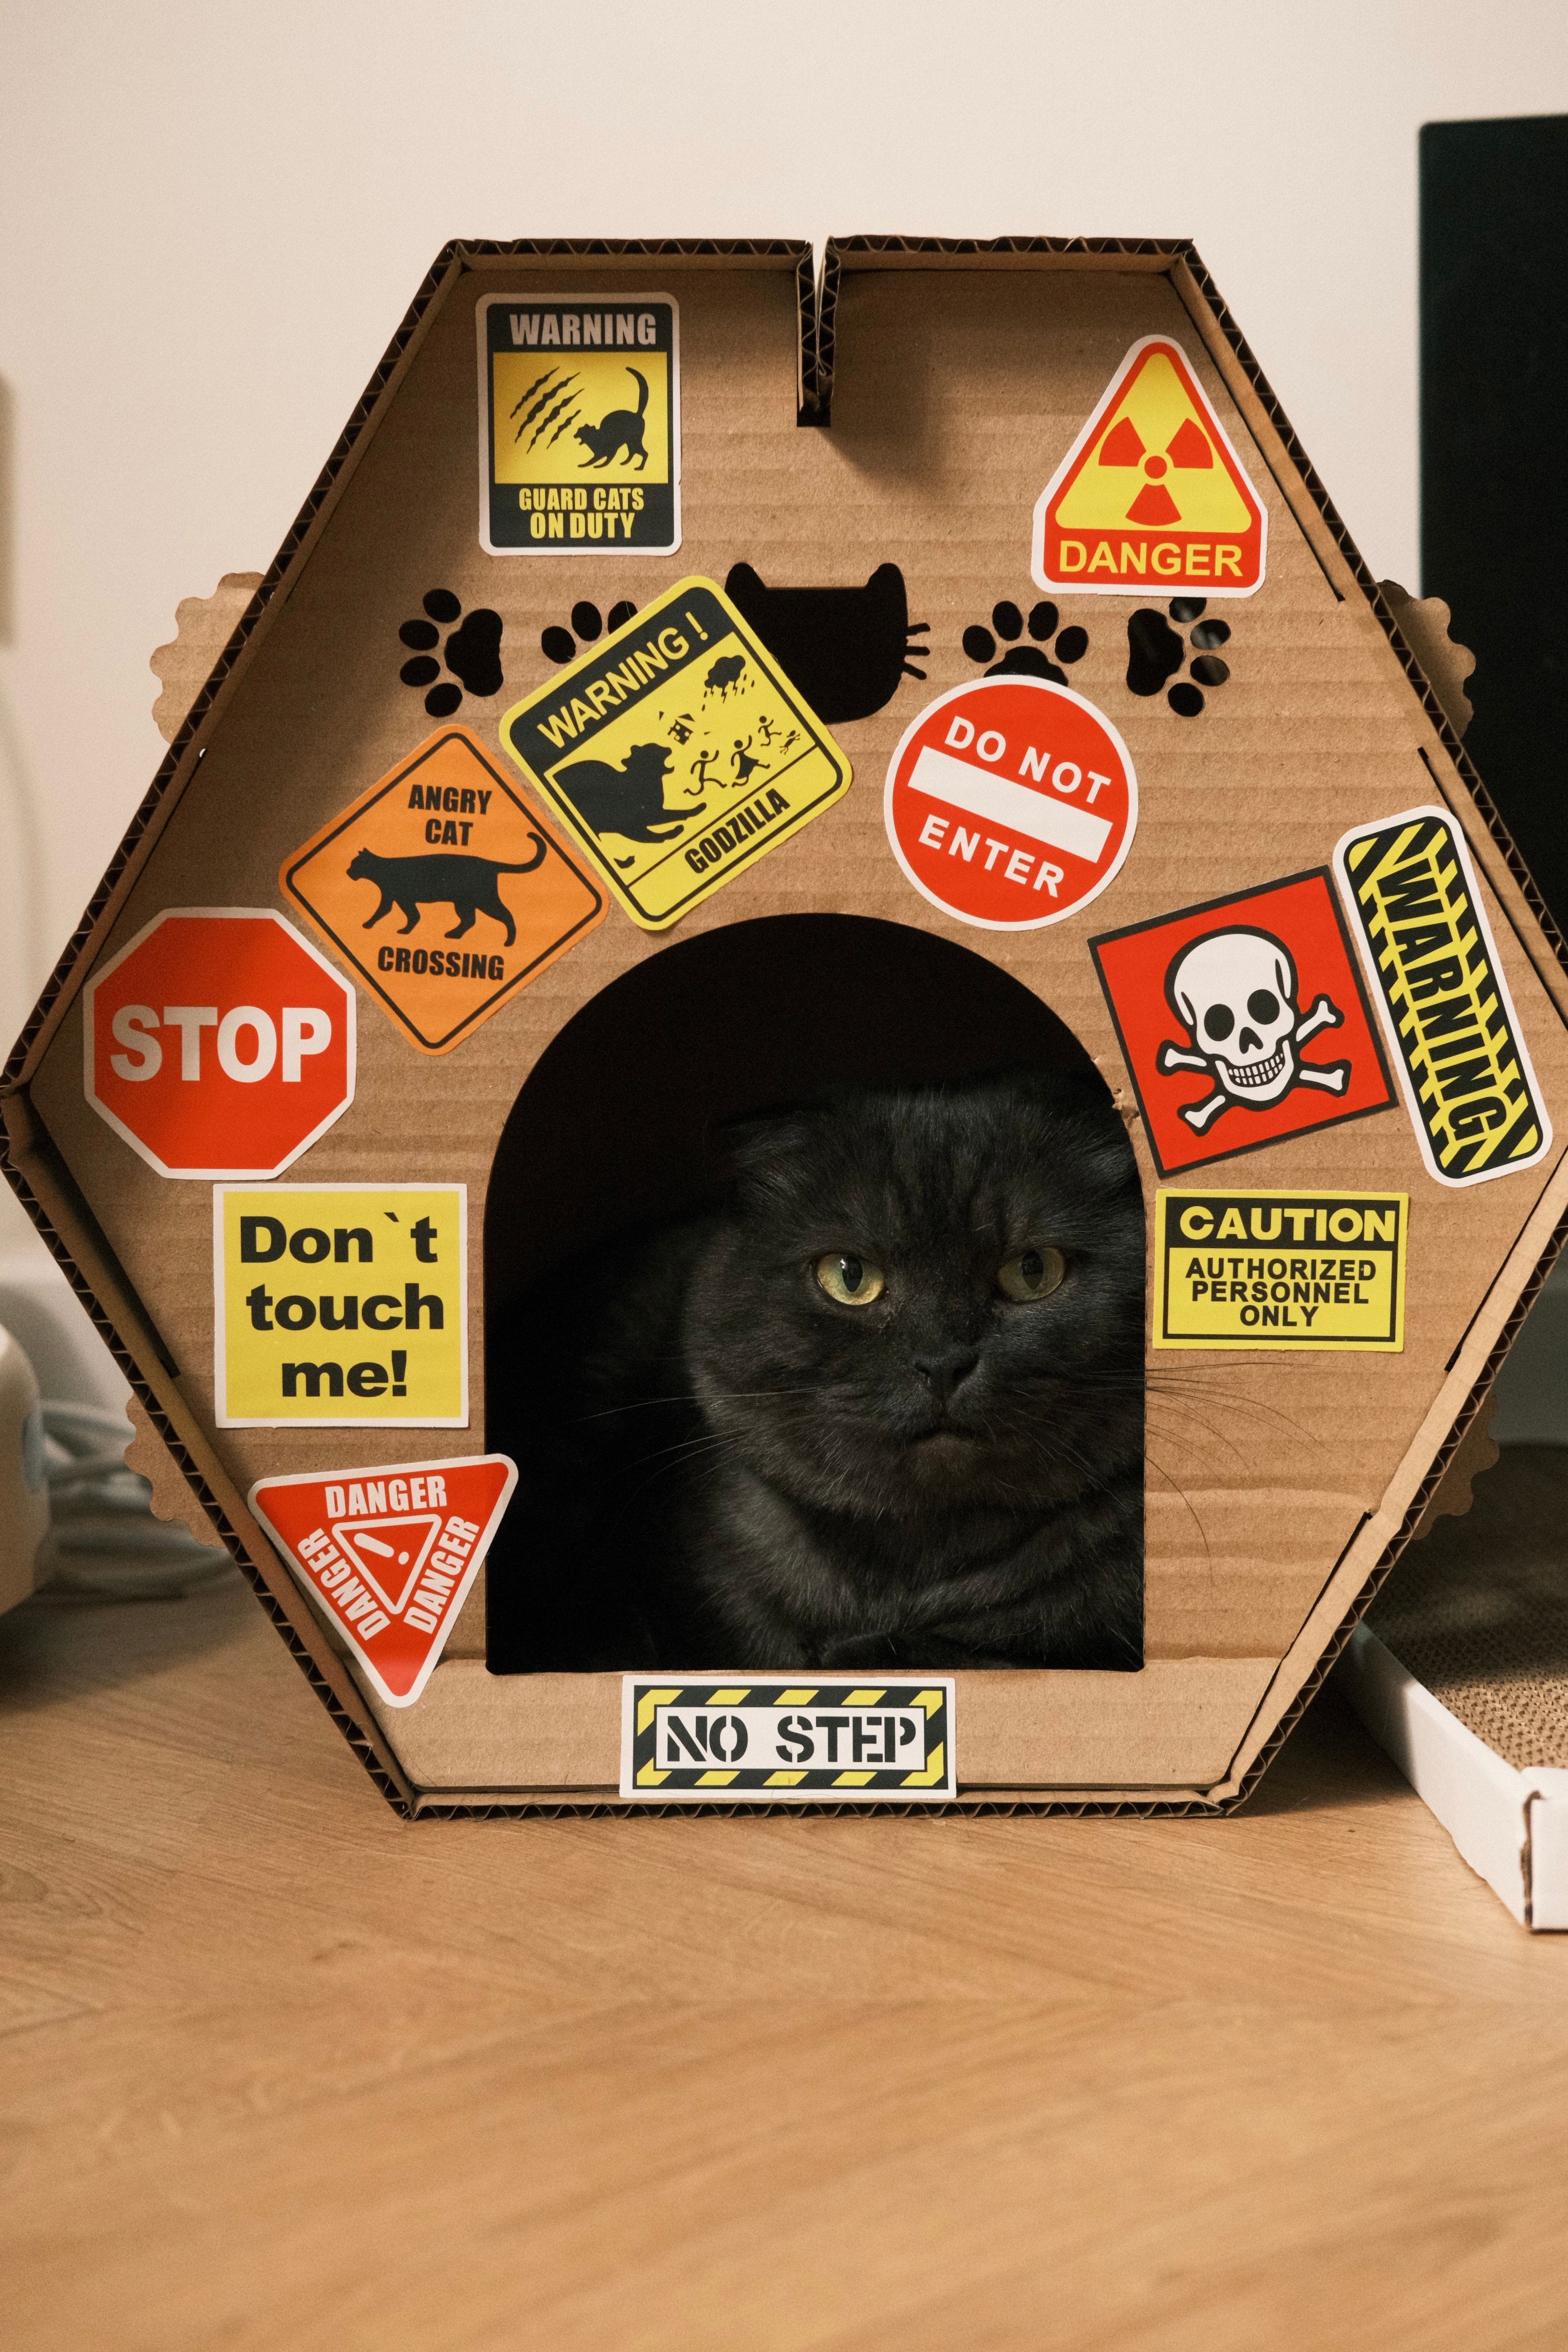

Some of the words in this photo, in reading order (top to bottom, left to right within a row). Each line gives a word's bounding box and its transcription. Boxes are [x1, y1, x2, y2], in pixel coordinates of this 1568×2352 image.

[510, 313, 656, 345] WARNING
[519, 488, 588, 511] GUARD
[593, 488, 644, 511] CATS
[530, 513, 564, 539] ON
[570, 512, 635, 539] DUTY
[1060, 540, 1243, 577] DANGER
[537, 627, 690, 749] WARNING
[944, 715, 1006, 762] DO
[1018, 746, 1112, 804] NOT
[408, 785, 492, 815] ANGRY
[425, 818, 473, 846] CAT
[684, 788, 791, 874] GODZILLA
[918, 814, 1064, 898] ENTER
[377, 946, 505, 980] CROSSING
[1376, 857, 1507, 1142] WARNING
[110, 1004, 332, 1083] STOP
[1179, 1206, 1396, 1242] CAUTION
[1185, 1257, 1376, 1281] AUTHORIZED
[246, 1282, 444, 1331] touch
[1192, 1280, 1369, 1304] PERSONNEL
[1240, 1305, 1319, 1327] ONLY
[282, 1350, 407, 1398] me!
[325, 1475, 447, 1519] DANGER
[297, 1527, 391, 1642] DANGER
[403, 1515, 480, 1635] DANGER
[667, 1715, 748, 1763] NO
[775, 1715, 916, 1763] STEP
